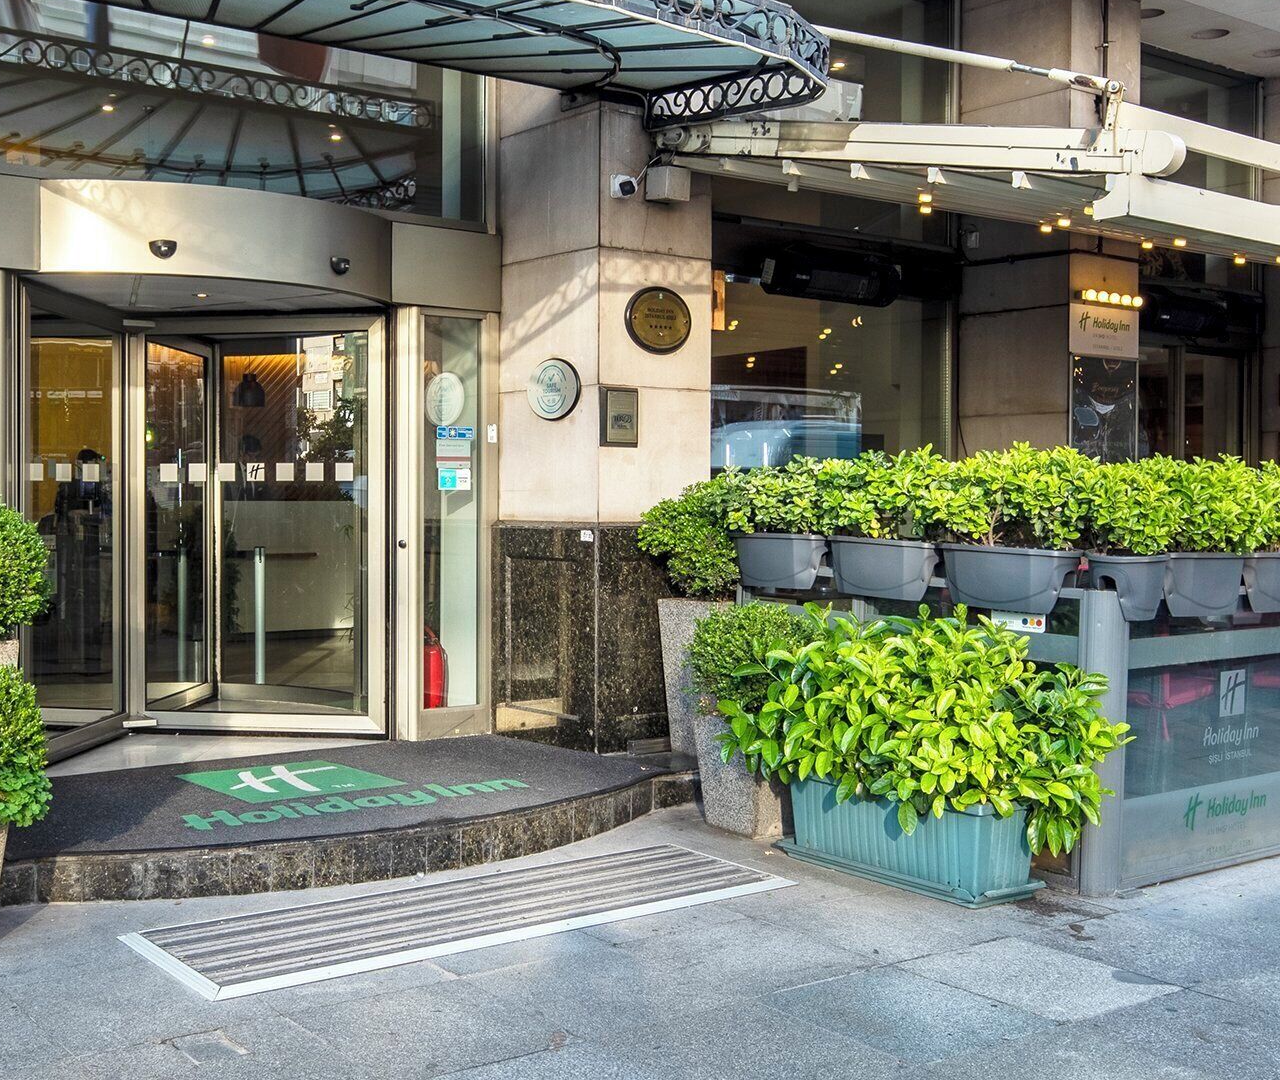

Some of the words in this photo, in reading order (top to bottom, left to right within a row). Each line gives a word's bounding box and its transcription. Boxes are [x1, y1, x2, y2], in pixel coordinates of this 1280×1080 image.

[1092, 316, 1119, 333] Holiday
[1119, 319, 1130, 332] Inn
[1203, 724, 1242, 748] Holiday
[1243, 722, 1260, 740] Inn
[182, 789, 437, 830] Holiday
[424, 778, 530, 797] Inn
[1206, 793, 1248, 819] Holiday
[1249, 790, 1267, 809] Inn
